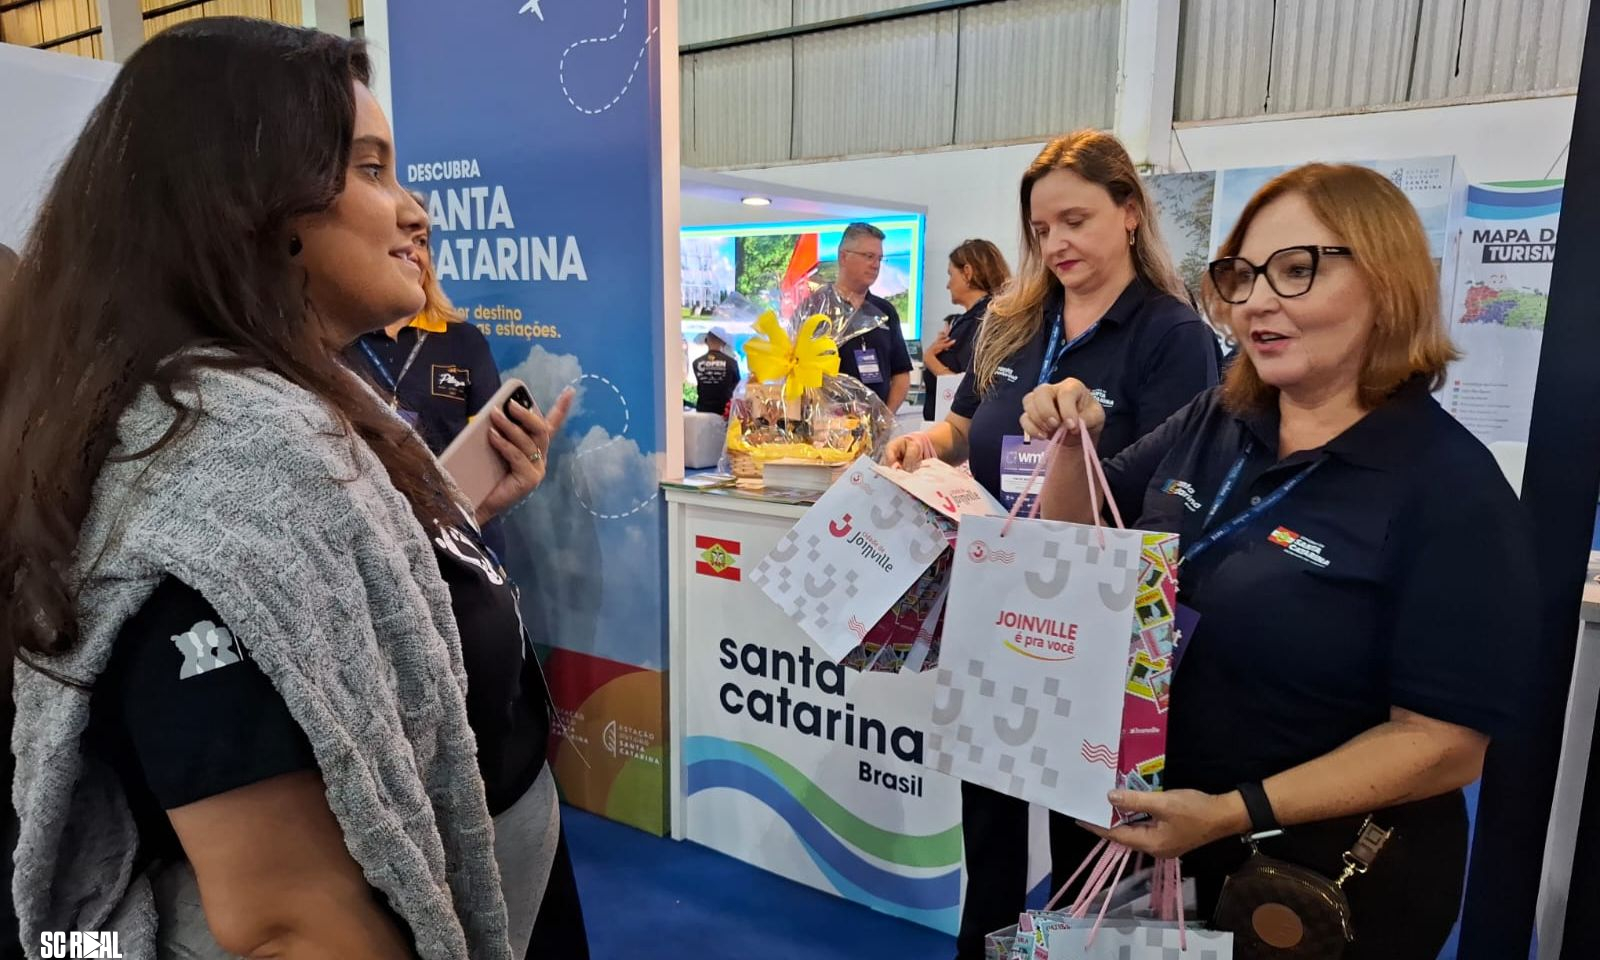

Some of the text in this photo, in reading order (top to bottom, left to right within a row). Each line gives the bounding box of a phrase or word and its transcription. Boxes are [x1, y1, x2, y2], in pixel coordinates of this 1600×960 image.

[408, 159, 480, 182] DESCUBRA
[429, 186, 515, 231] ANTA
[1472, 228, 1555, 243] MAPA D
[431, 236, 588, 281] ATARINA
[1489, 245, 1556, 261] TURISM
[474, 304, 522, 320] destino
[496, 321, 561, 340] estações.
[847, 531, 894, 573] Joinville
[996, 610, 1078, 640] JOINVILLE
[1015, 631, 1075, 655] é pra você
[720, 638, 846, 697] santa
[720, 682, 924, 765] catarina
[619, 740, 645, 752] SANTA
[859, 761, 923, 797] Brasil
